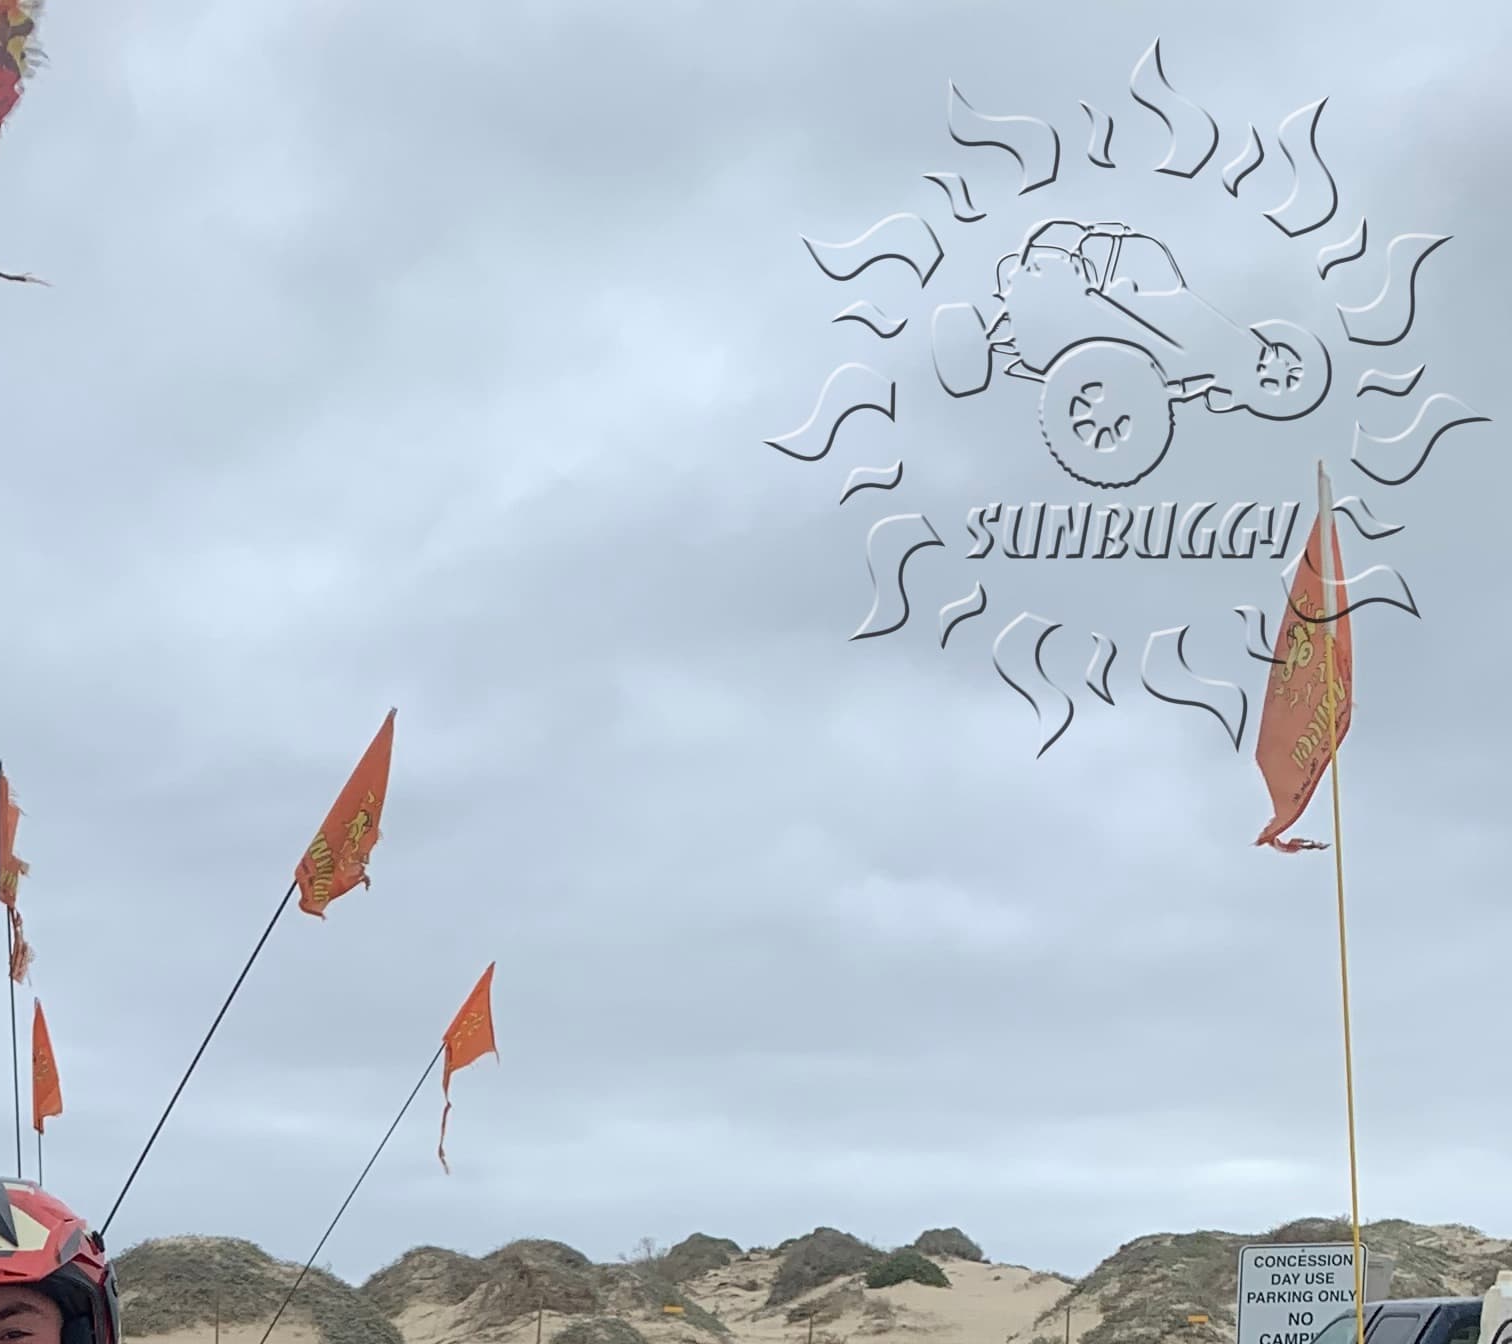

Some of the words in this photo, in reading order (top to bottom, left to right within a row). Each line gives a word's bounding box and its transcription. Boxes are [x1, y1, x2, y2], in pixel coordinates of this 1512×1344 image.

[1254, 1254, 1354, 1268] CONCESSION
[1271, 1273, 1300, 1286] DAY
[1305, 1272, 1335, 1285] USE
[1247, 1290, 1313, 1303] PARKING
[1318, 1290, 1357, 1302] ONLY
[1288, 1312, 1314, 1326] NO
